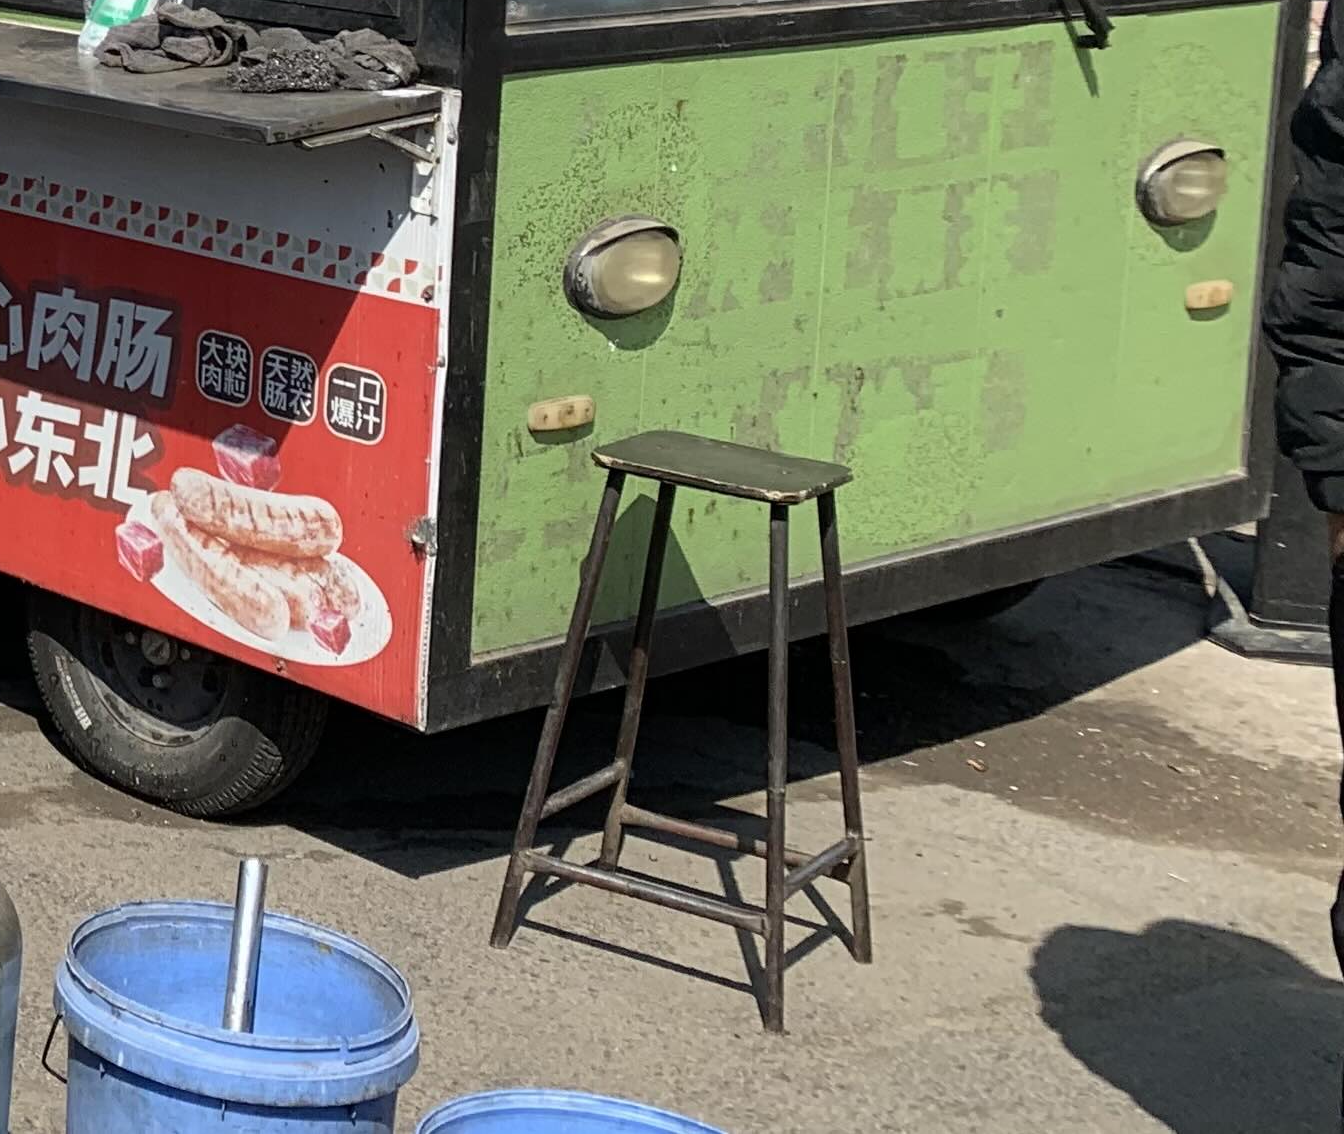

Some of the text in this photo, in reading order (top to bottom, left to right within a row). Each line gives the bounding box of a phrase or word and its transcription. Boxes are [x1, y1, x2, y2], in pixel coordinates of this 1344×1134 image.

[202, 338, 248, 373] 大块
[266, 352, 313, 391] 天然
[200, 365, 247, 400] 肉粒
[264, 379, 312, 417] 肠衣
[332, 376, 382, 406] 一口
[330, 396, 382, 435] 爆汁
